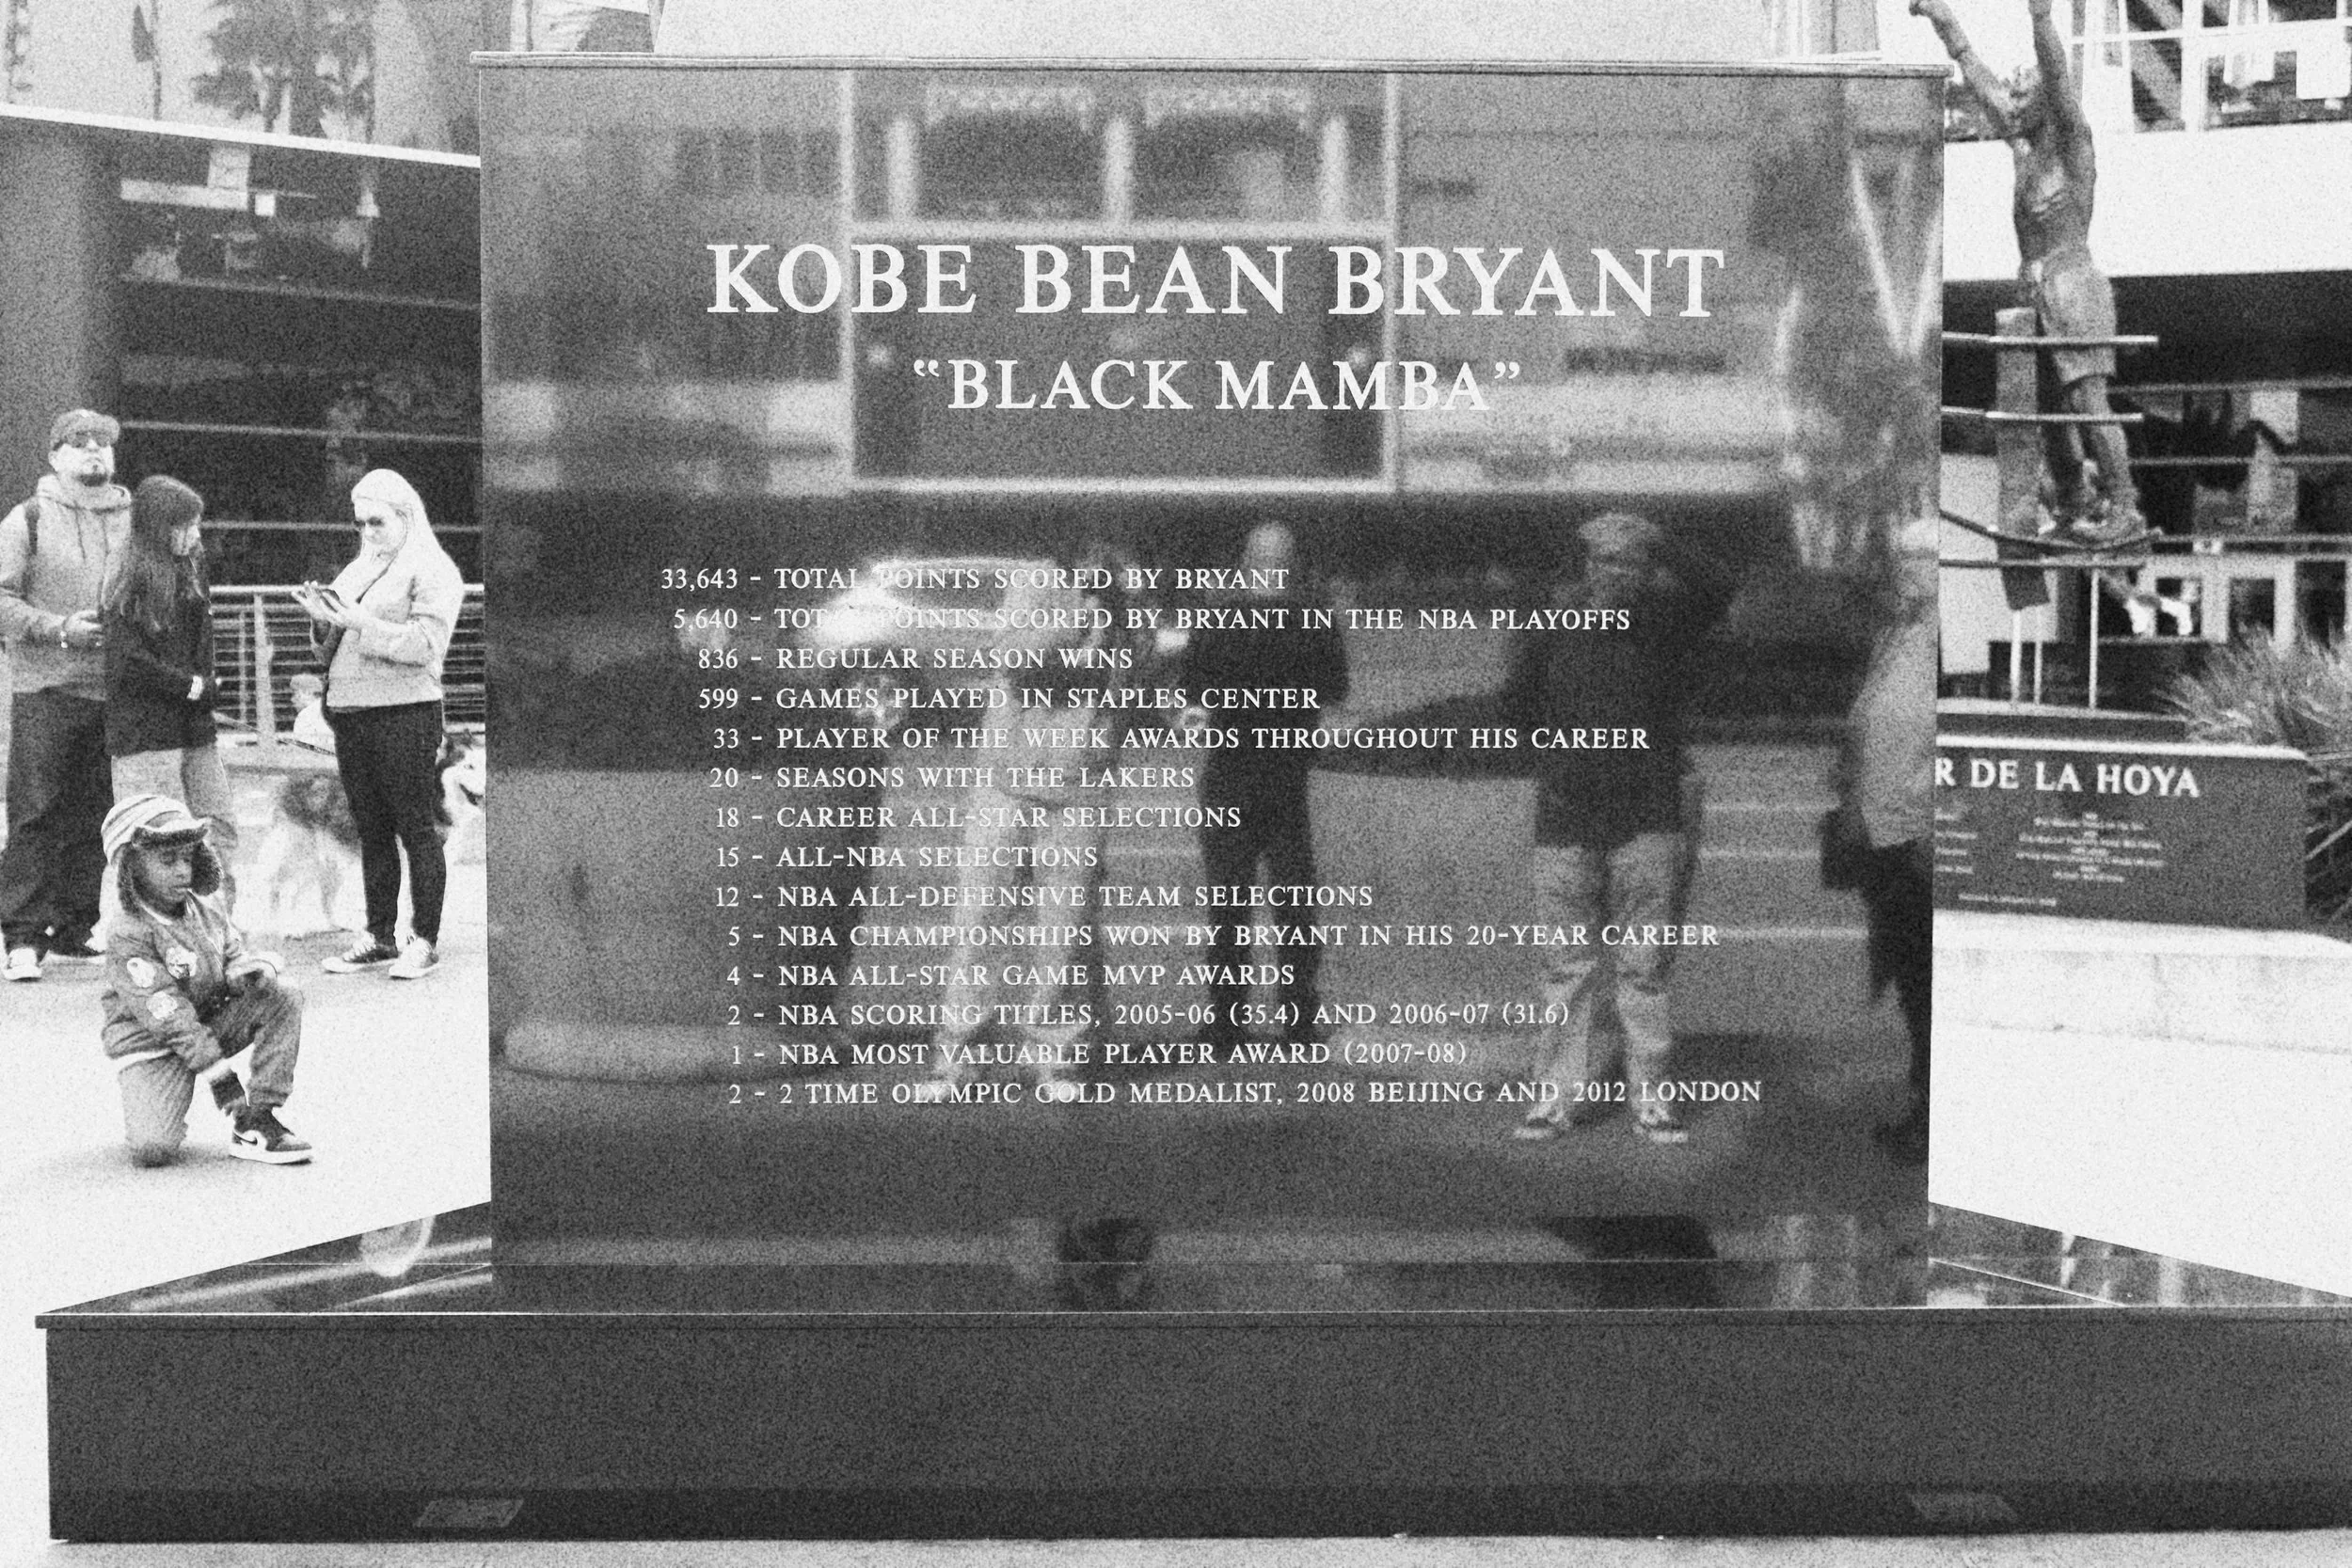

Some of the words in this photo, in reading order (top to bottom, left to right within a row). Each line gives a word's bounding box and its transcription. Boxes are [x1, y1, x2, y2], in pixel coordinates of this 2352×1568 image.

[707, 244, 977, 314] KOBE
[1015, 244, 1293, 314] BEAN
[1327, 245, 1724, 317] BRYANT
[660, 569, 739, 592] 33,643
[773, 568, 862, 590] TOTAL
[879, 568, 980, 590] POINTS
[994, 568, 1113, 590] SCORED
[1125, 568, 1162, 590] BY
[1175, 568, 1290, 590] BRYANT
[674, 610, 738, 632] 5,640
[994, 609, 1113, 630] SCORED
[1125, 609, 1162, 630] BY
[1175, 609, 1290, 629] BRYANT
[1301, 609, 1333, 629] IN
[1345, 609, 1404, 629] THE
[1418, 610, 1478, 630] NBA
[1489, 610, 1630, 631] PLAYOFFS
[698, 648, 739, 670] 836
[776, 648, 923, 670] REGULAR
[932, 648, 1045, 670] SEASON
[1057, 648, 1134, 670] WINS
[698, 689, 739, 709] 599
[775, 688, 879, 709] GAMES
[893, 688, 1008, 709] PLAYED
[1020, 688, 1054, 709] IN
[1067, 688, 1187, 710] STAPLES
[1200, 688, 1321, 709] CENTER
[713, 728, 739, 750] 33
[776, 728, 890, 750] PLAYER
[902, 728, 940, 750] OF
[951, 728, 1009, 750] THE
[1024, 728, 1110, 750] WEEK
[1121, 728, 1239, 750] AWARDS
[1252, 728, 1457, 750] THROUGHOUT
[1470, 728, 1518, 750] HIS
[1531, 728, 1650, 750] CAREER
[709, 768, 739, 788] 20
[776, 767, 905, 789] SEASONS
[917, 767, 994, 788] WITH
[1007, 767, 1065, 788] THE
[1078, 767, 1195, 788] LAKERS
[1970, 759, 2019, 789] DE
[2035, 762, 2083, 792] LA
[2097, 763, 2200, 798] HOYA
[715, 807, 739, 828] 18
[776, 807, 897, 829] CAREER
[908, 807, 1048, 829] ALL-STAR
[1062, 806, 1241, 829] SELECTIONS
[716, 847, 739, 868] 15
[776, 847, 906, 868] ALL-NBA
[918, 846, 1098, 868] SELECTIONS
[715, 886, 739, 908] 12
[777, 886, 837, 908] NBA
[849, 886, 1087, 908] ALL-DEFENSIVE
[1099, 886, 1181, 908] TEAM
[1194, 885, 1373, 907] SELECTIONS
[728, 926, 739, 947] 5
[778, 926, 837, 947] NBA
[850, 926, 1093, 947] CHAMPIONSHIPS
[1105, 926, 1171, 946] WON
[1184, 926, 1222, 946] BY
[1234, 926, 1348, 946] BRYANT
[1359, 926, 1392, 946] IN
[1406, 926, 1454, 946] HIS
[1467, 925, 1589, 946] 20-YEAR
[1601, 925, 1720, 946] CAREER
[726, 965, 739, 987] 4
[778, 965, 837, 987] NBA
[850, 965, 990, 987] ALL-STAR
[1002, 965, 1089, 987] GAME
[1103, 965, 1166, 987] MVP
[1176, 965, 1295, 987] AWARDS
[727, 1005, 740, 1025] 2
[778, 1005, 838, 1026] NBA
[850, 1005, 982, 1026] SCORING
[993, 1004, 1101, 1028] TITLES,
[1114, 1004, 1216, 1026] 2005-06
[1229, 1003, 1300, 1026] (35.4)
[1312, 1004, 1376, 1025] AND
[1390, 1004, 1489, 1025] 2006-07
[1502, 1003, 1569, 1025] (31.6)
[732, 1045, 740, 1065] 1
[779, 1045, 838, 1066] NBA
[851, 1044, 929, 1066] MOST
[940, 1044, 1090, 1065] VALUABLE
[1104, 1044, 1216, 1065] PLAYER
[1229, 1044, 1329, 1064] AWARD
[1343, 1043, 1467, 1066] (2007-08)
[728, 1085, 740, 1105] 2
[780, 1085, 792, 1105] 2
[804, 1084, 878, 1105] TIME
[892, 1084, 1022, 1105] OLYMPIC
[1035, 1084, 1115, 1105] GOLD
[1129, 1084, 1283, 1107] MEDALIST,
[1297, 1083, 1355, 1103] 2008
[1368, 1083, 1485, 1103] BEIJING
[1496, 1083, 1559, 1103] AND
[1572, 1082, 1627, 1102] 2012
[1641, 1081, 1761, 1103] LONDON
